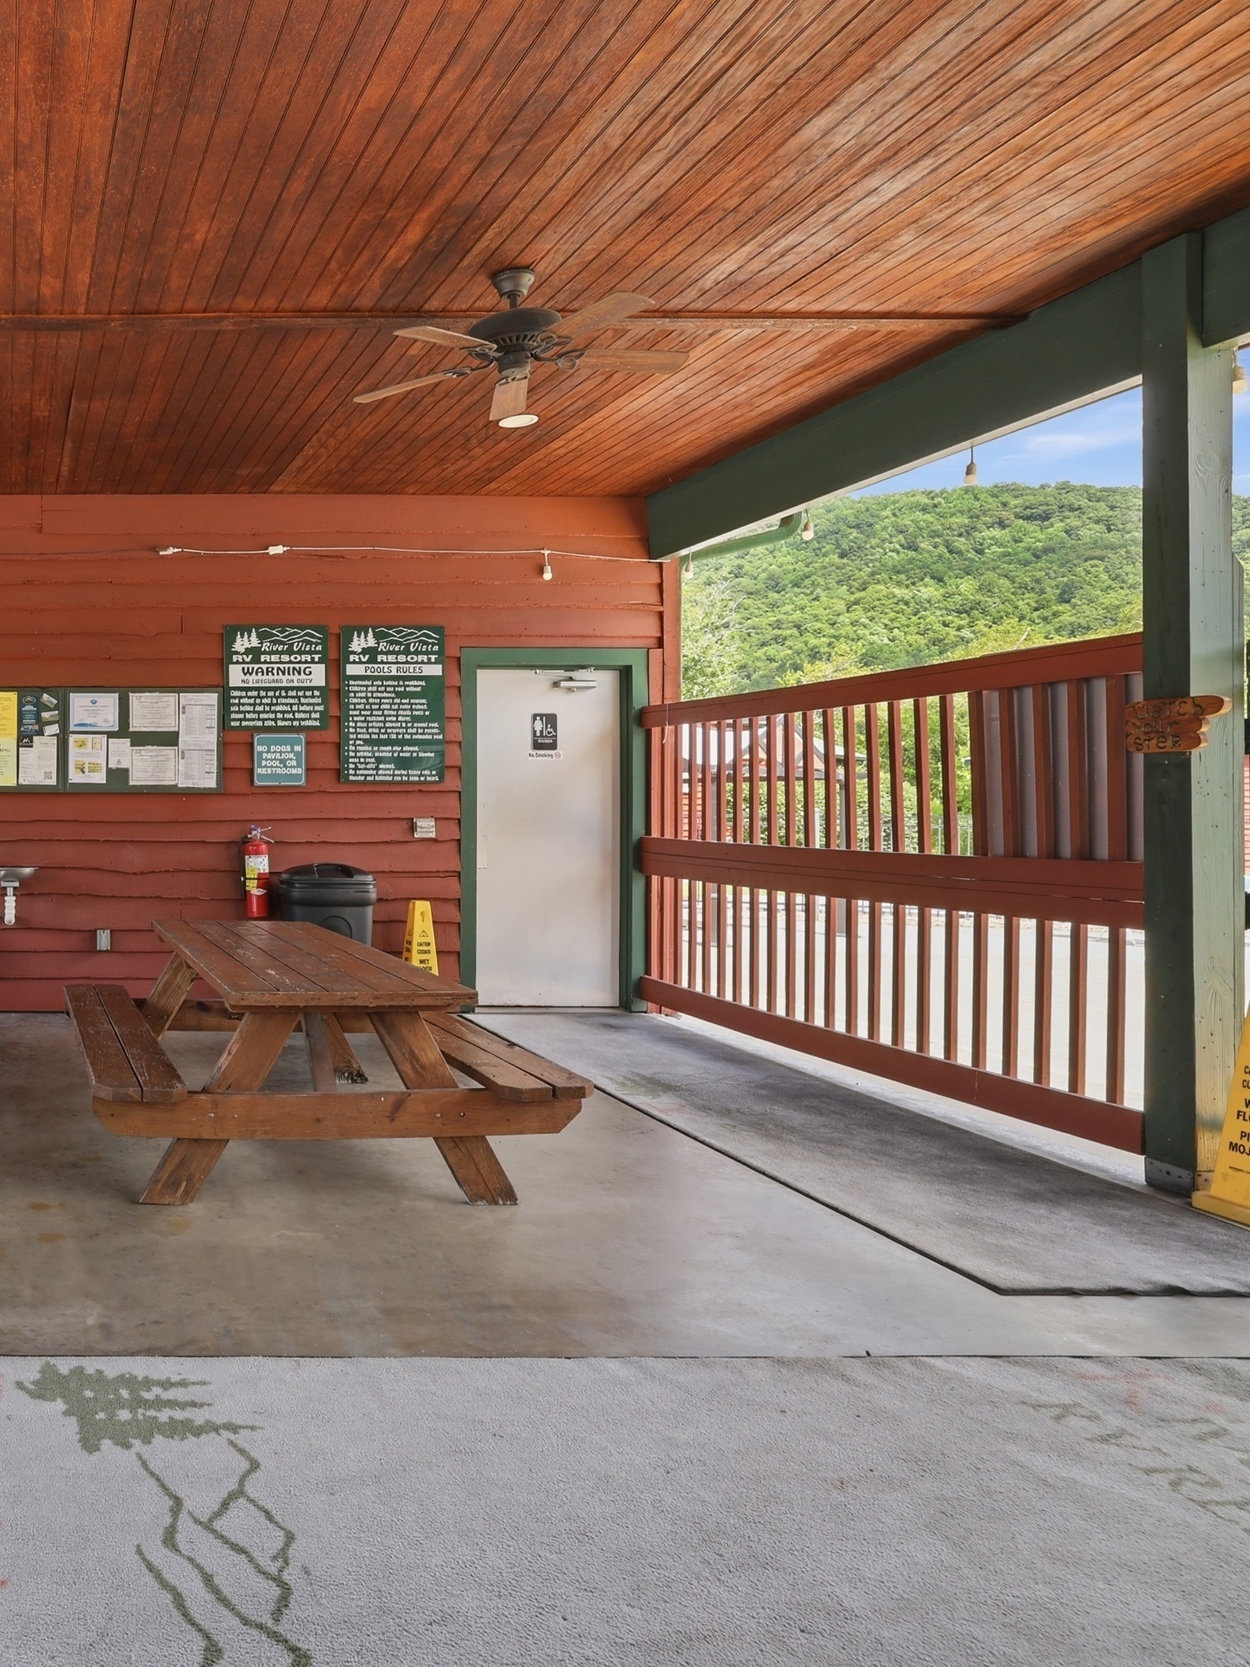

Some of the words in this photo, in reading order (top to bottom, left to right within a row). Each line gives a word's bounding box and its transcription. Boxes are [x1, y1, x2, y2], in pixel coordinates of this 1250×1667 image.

[261, 642, 288, 651] River
[293, 642, 322, 651] Vista
[378, 642, 405, 651] River
[410, 642, 439, 651] Vista
[232, 654, 252, 662] RV
[260, 654, 322, 662] RESORT
[350, 654, 369, 662] RV
[377, 654, 438, 662] RESORT
[241, 666, 312, 676] WARNING
[364, 666, 392, 674] POOLS
[396, 666, 423, 674] RULES
